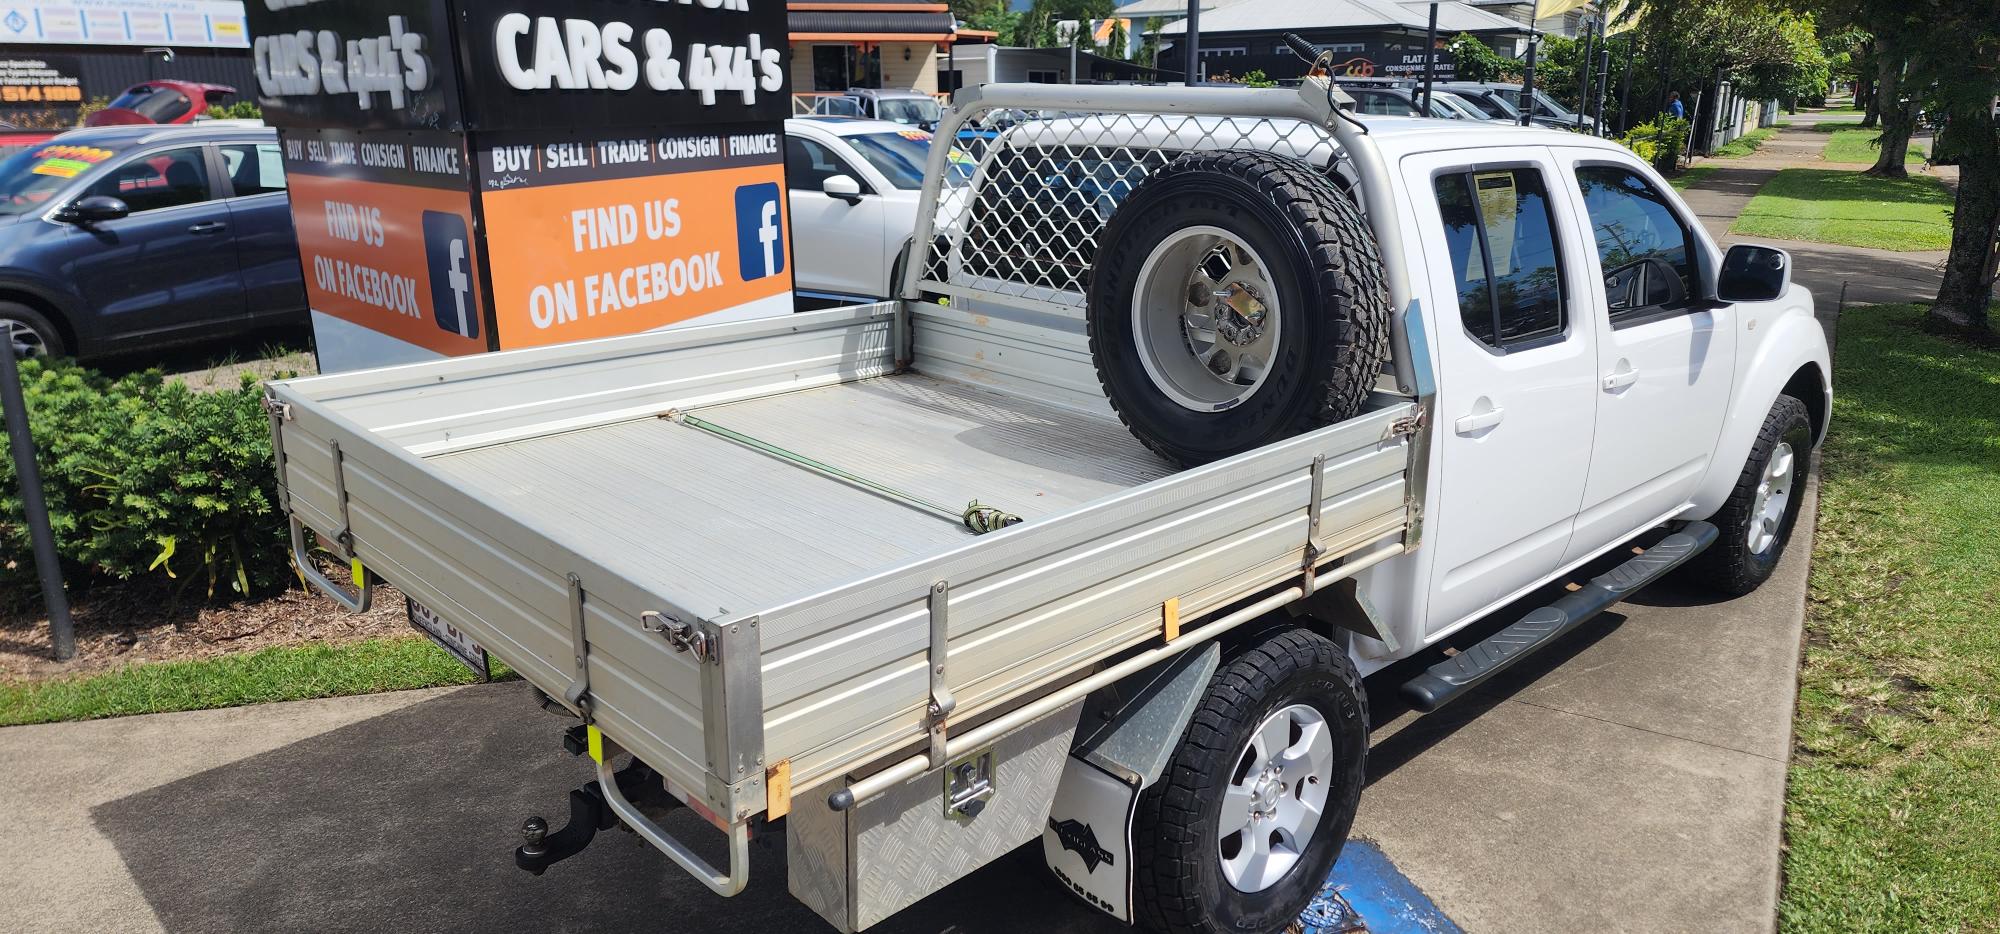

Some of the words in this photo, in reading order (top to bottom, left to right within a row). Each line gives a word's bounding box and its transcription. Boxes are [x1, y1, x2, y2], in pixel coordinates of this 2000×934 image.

[254, 29, 320, 97] CARS
[318, 29, 348, 95] &
[495, 12, 639, 91] CARS
[643, 27, 685, 91] &
[1385, 64, 1426, 72] CONSIGNME
[1402, 54, 1424, 64] FLAT
[286, 139, 303, 161] BUY
[306, 140, 327, 163] SELL
[329, 140, 357, 165] TRADE
[361, 142, 406, 169] CONSIGN
[412, 146, 460, 175] FINANCE
[492, 145, 532, 174] BUY
[546, 142, 588, 169] SELL
[597, 139, 649, 165] TRADE
[658, 135, 721, 161] CONSIGN
[728, 133, 778, 156] FINANCE
[323, 200, 357, 240] FIND
[356, 204, 385, 248] US
[571, 203, 639, 253] FIND
[642, 198, 681, 239] US
[313, 254, 336, 292] ON
[334, 259, 421, 319] FACEBOOK
[528, 282, 578, 330] ON
[584, 251, 724, 317] FACEBOOK
